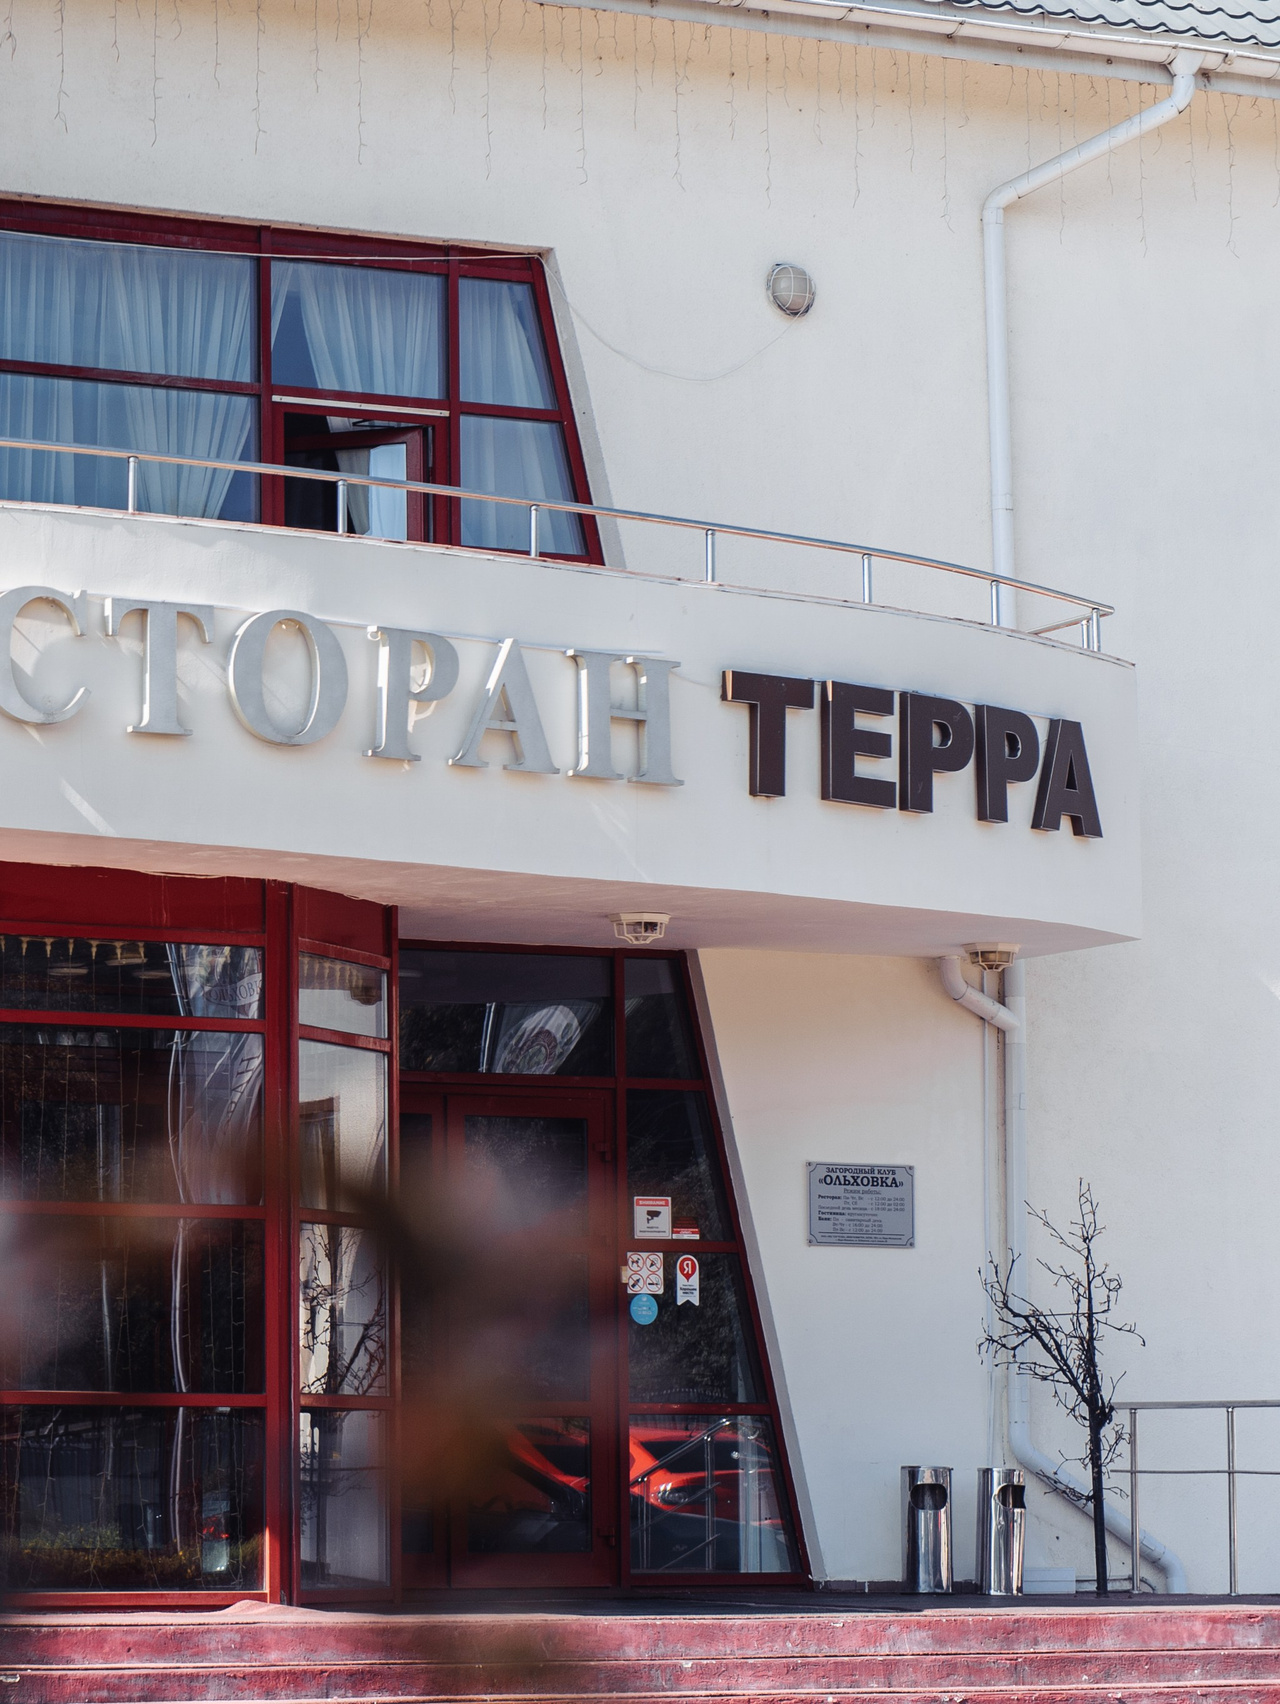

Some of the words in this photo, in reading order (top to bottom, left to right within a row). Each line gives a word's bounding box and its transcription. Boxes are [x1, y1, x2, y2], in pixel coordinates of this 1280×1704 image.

[721, 668, 1104, 839] ТЕРРА
[825, 1167, 875, 1175] ЗАГОРОДНЫЙ
[818, 1174, 904, 1188] «ОЛЬХОВКА»
[683, 1260, 692, 1274] Я
